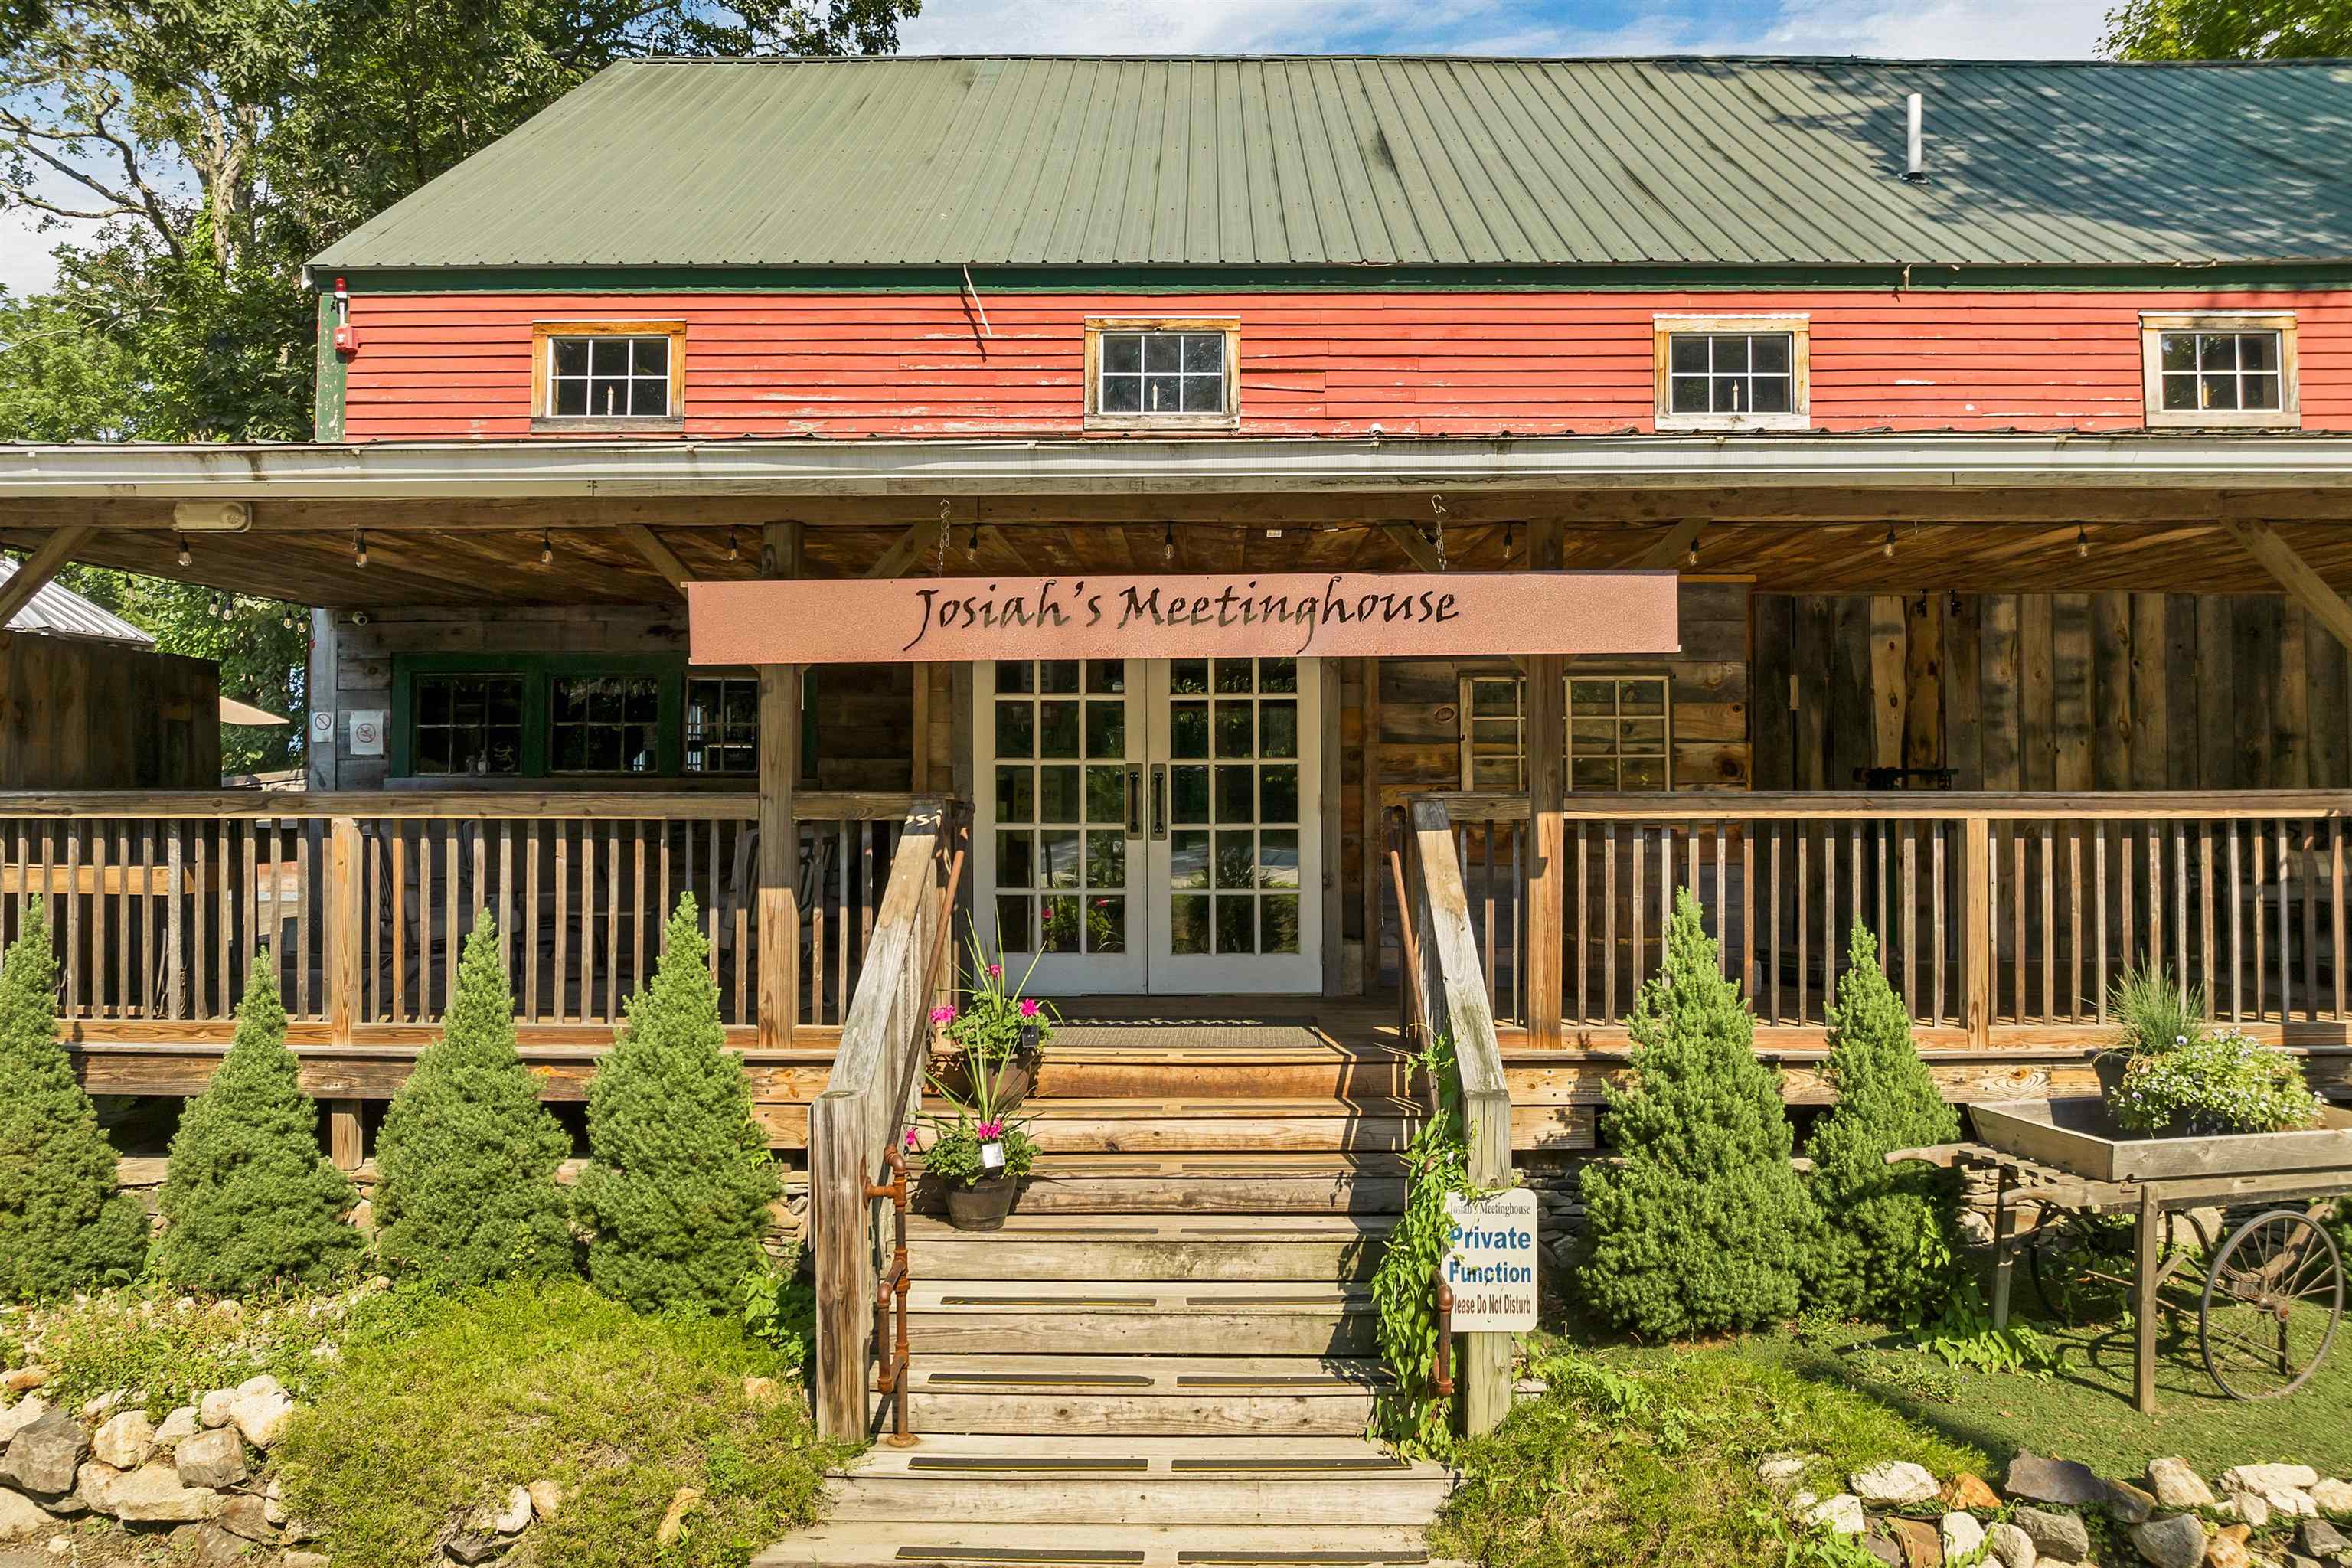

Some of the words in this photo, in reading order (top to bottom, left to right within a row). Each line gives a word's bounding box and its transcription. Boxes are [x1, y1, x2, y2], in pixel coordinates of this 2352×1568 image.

[903, 579, 1102, 652] Josiah's
[1117, 575, 1459, 655] Meetinghouse
[1480, 1202, 1530, 1217] Meetinghouse
[1449, 1225, 1531, 1250] Private
[1449, 1261, 1531, 1282] Function
[1455, 1293, 1475, 1314] lease
[1477, 1293, 1487, 1314] Do
[1488, 1293, 1502, 1314] Not
[1504, 1293, 1531, 1314] Disturb
